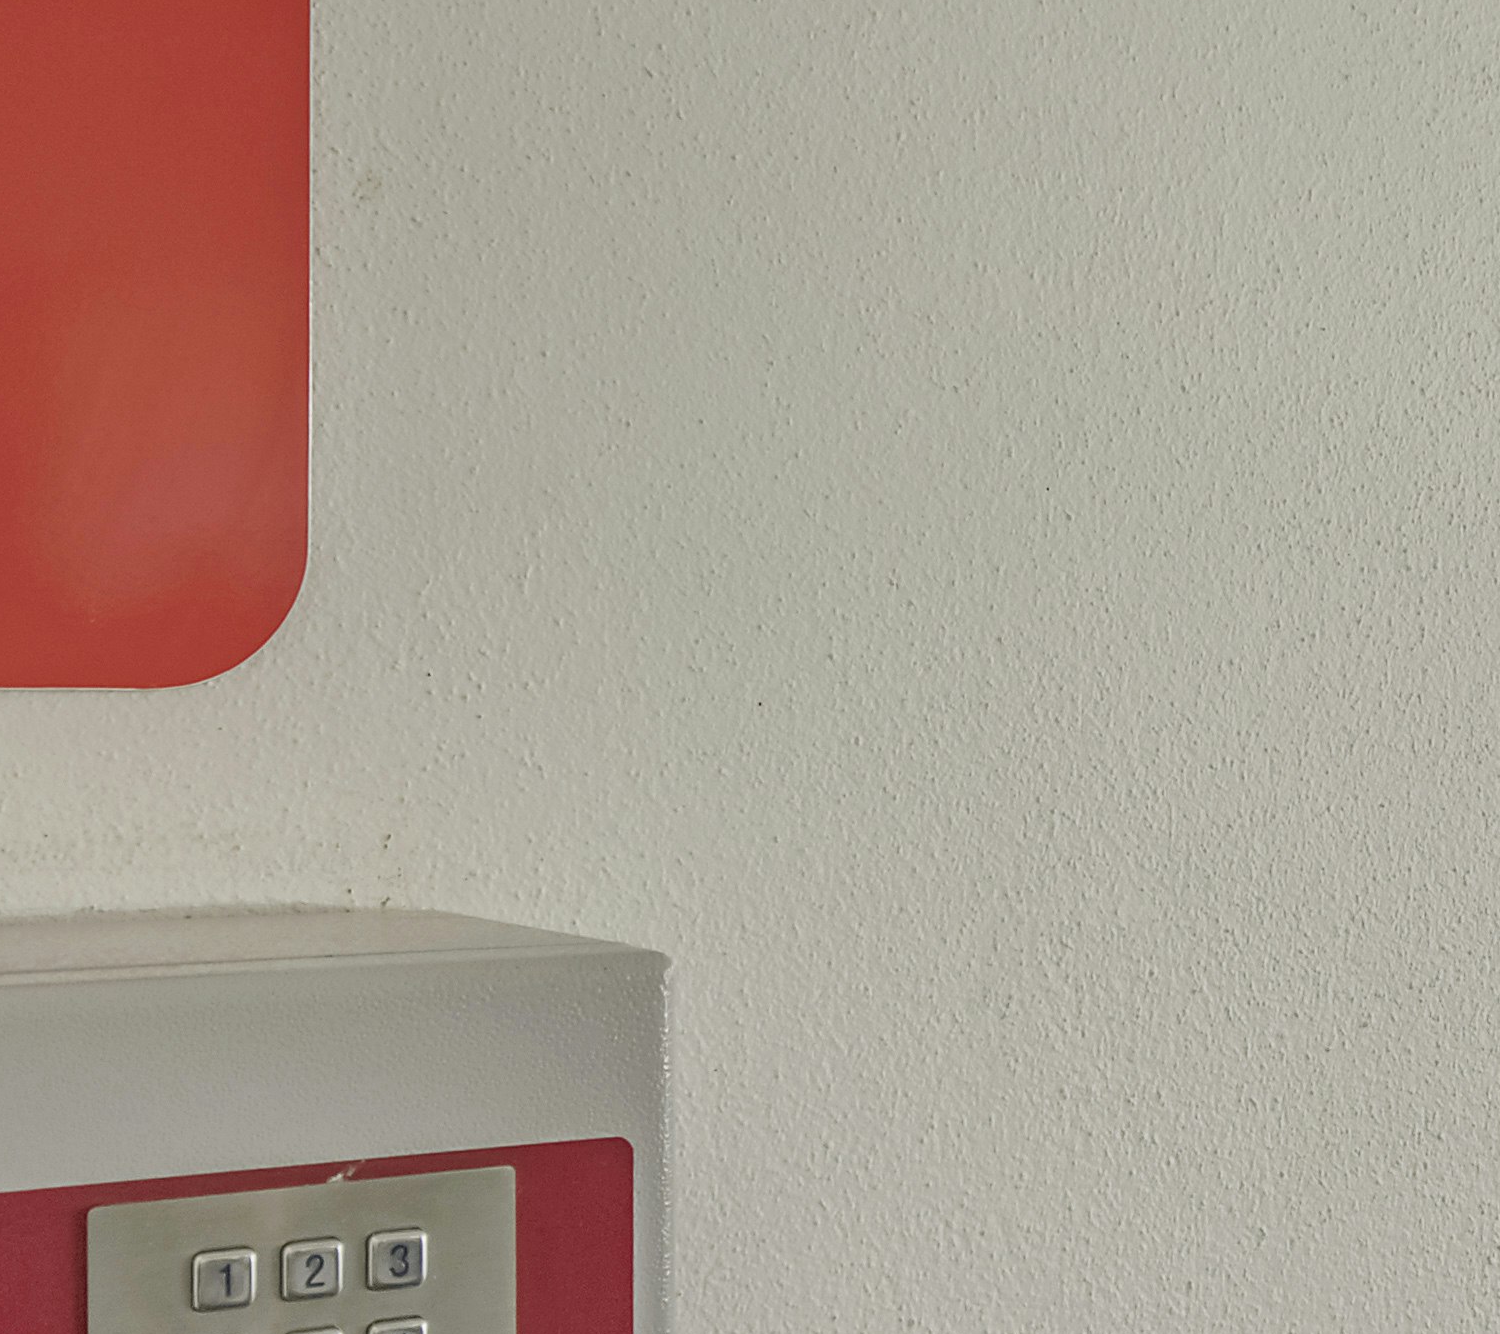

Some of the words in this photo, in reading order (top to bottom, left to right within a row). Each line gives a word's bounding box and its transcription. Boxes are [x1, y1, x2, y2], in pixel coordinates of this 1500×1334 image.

[218, 1263, 233, 1296] 1
[304, 1253, 326, 1288] 2
[389, 1244, 410, 1278] 3
